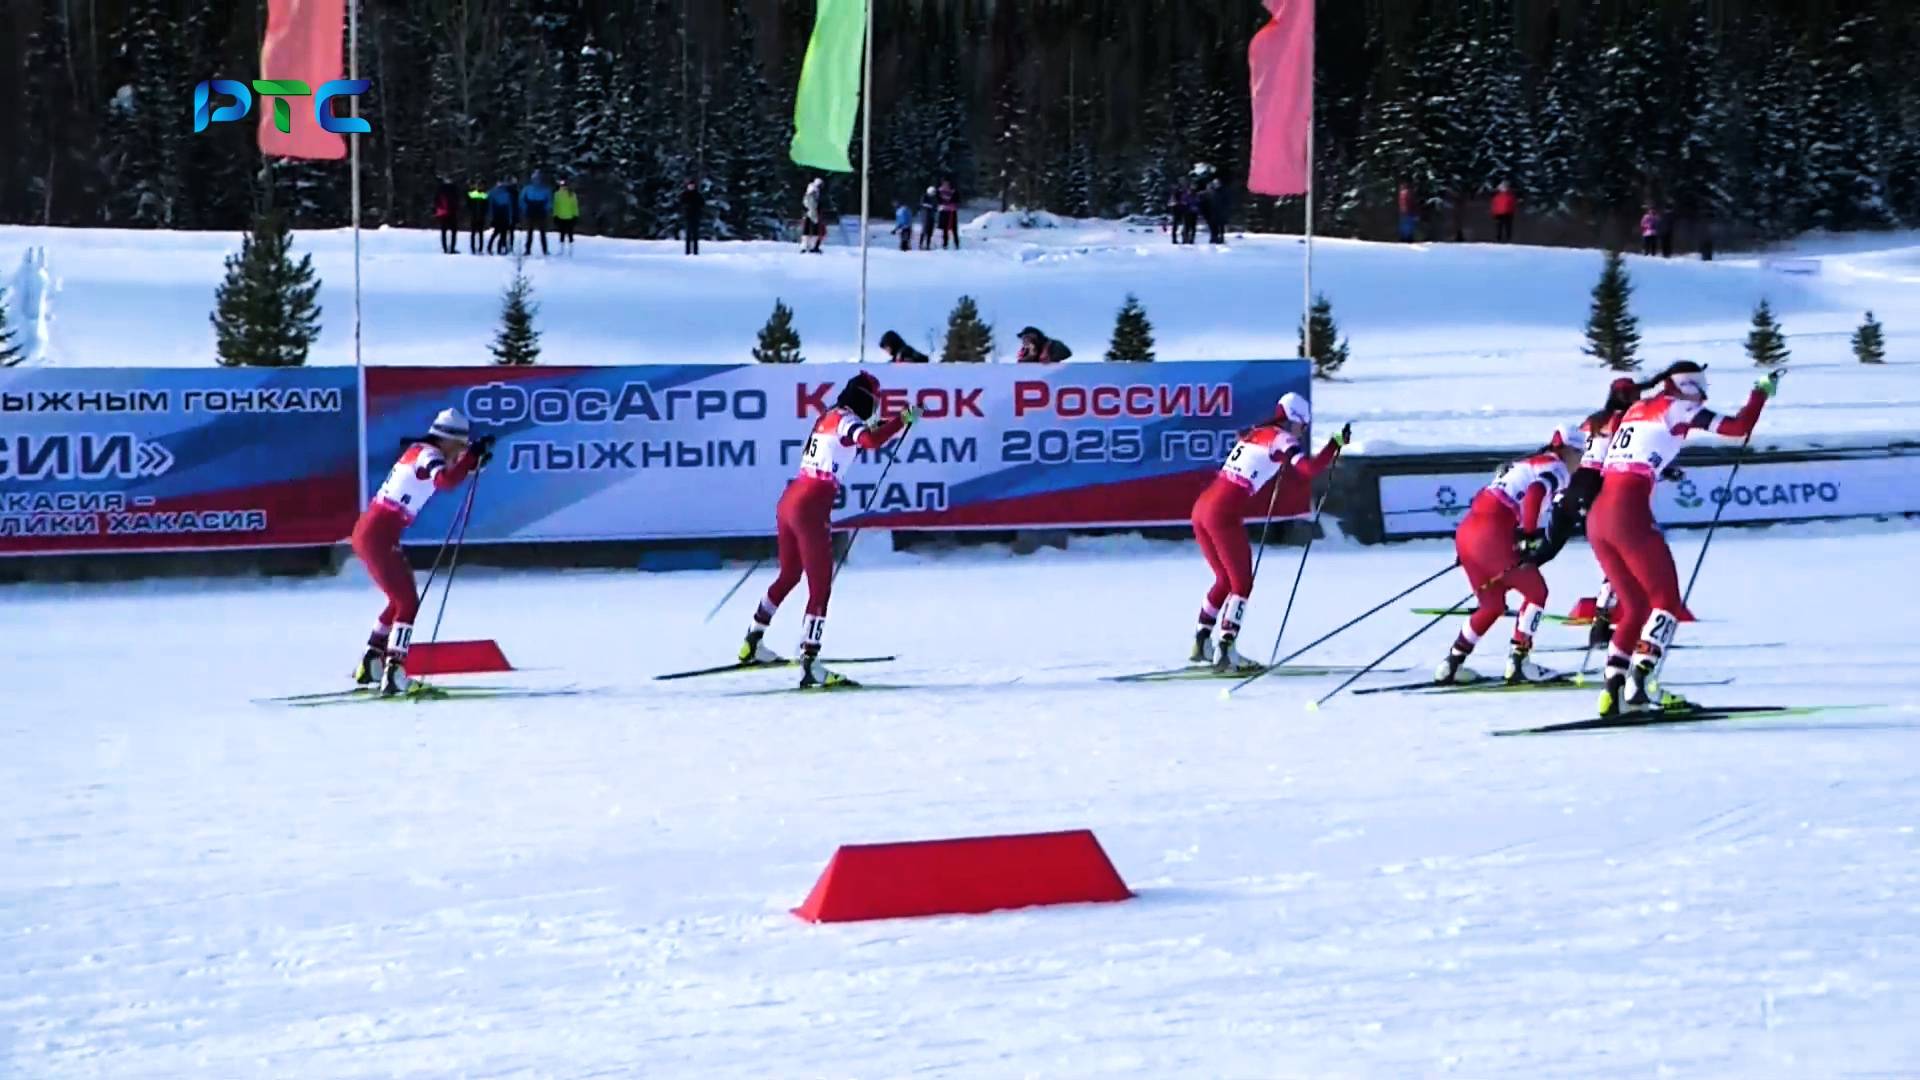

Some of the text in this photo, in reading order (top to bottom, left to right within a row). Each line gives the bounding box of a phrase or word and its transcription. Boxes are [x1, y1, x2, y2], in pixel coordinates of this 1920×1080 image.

[184, 389, 341, 410] ГОНКАМ
[0, 434, 172, 477] ИИ»
[509, 440, 756, 470] ЛЫЖНЫМ
[1002, 428, 1141, 462] 2025
[0, 493, 123, 513] КАСИЯ
[108, 512, 266, 532] ХАКАСИЯ
[1235, 600, 1247, 621] 5
[808, 618, 825, 641] 15
